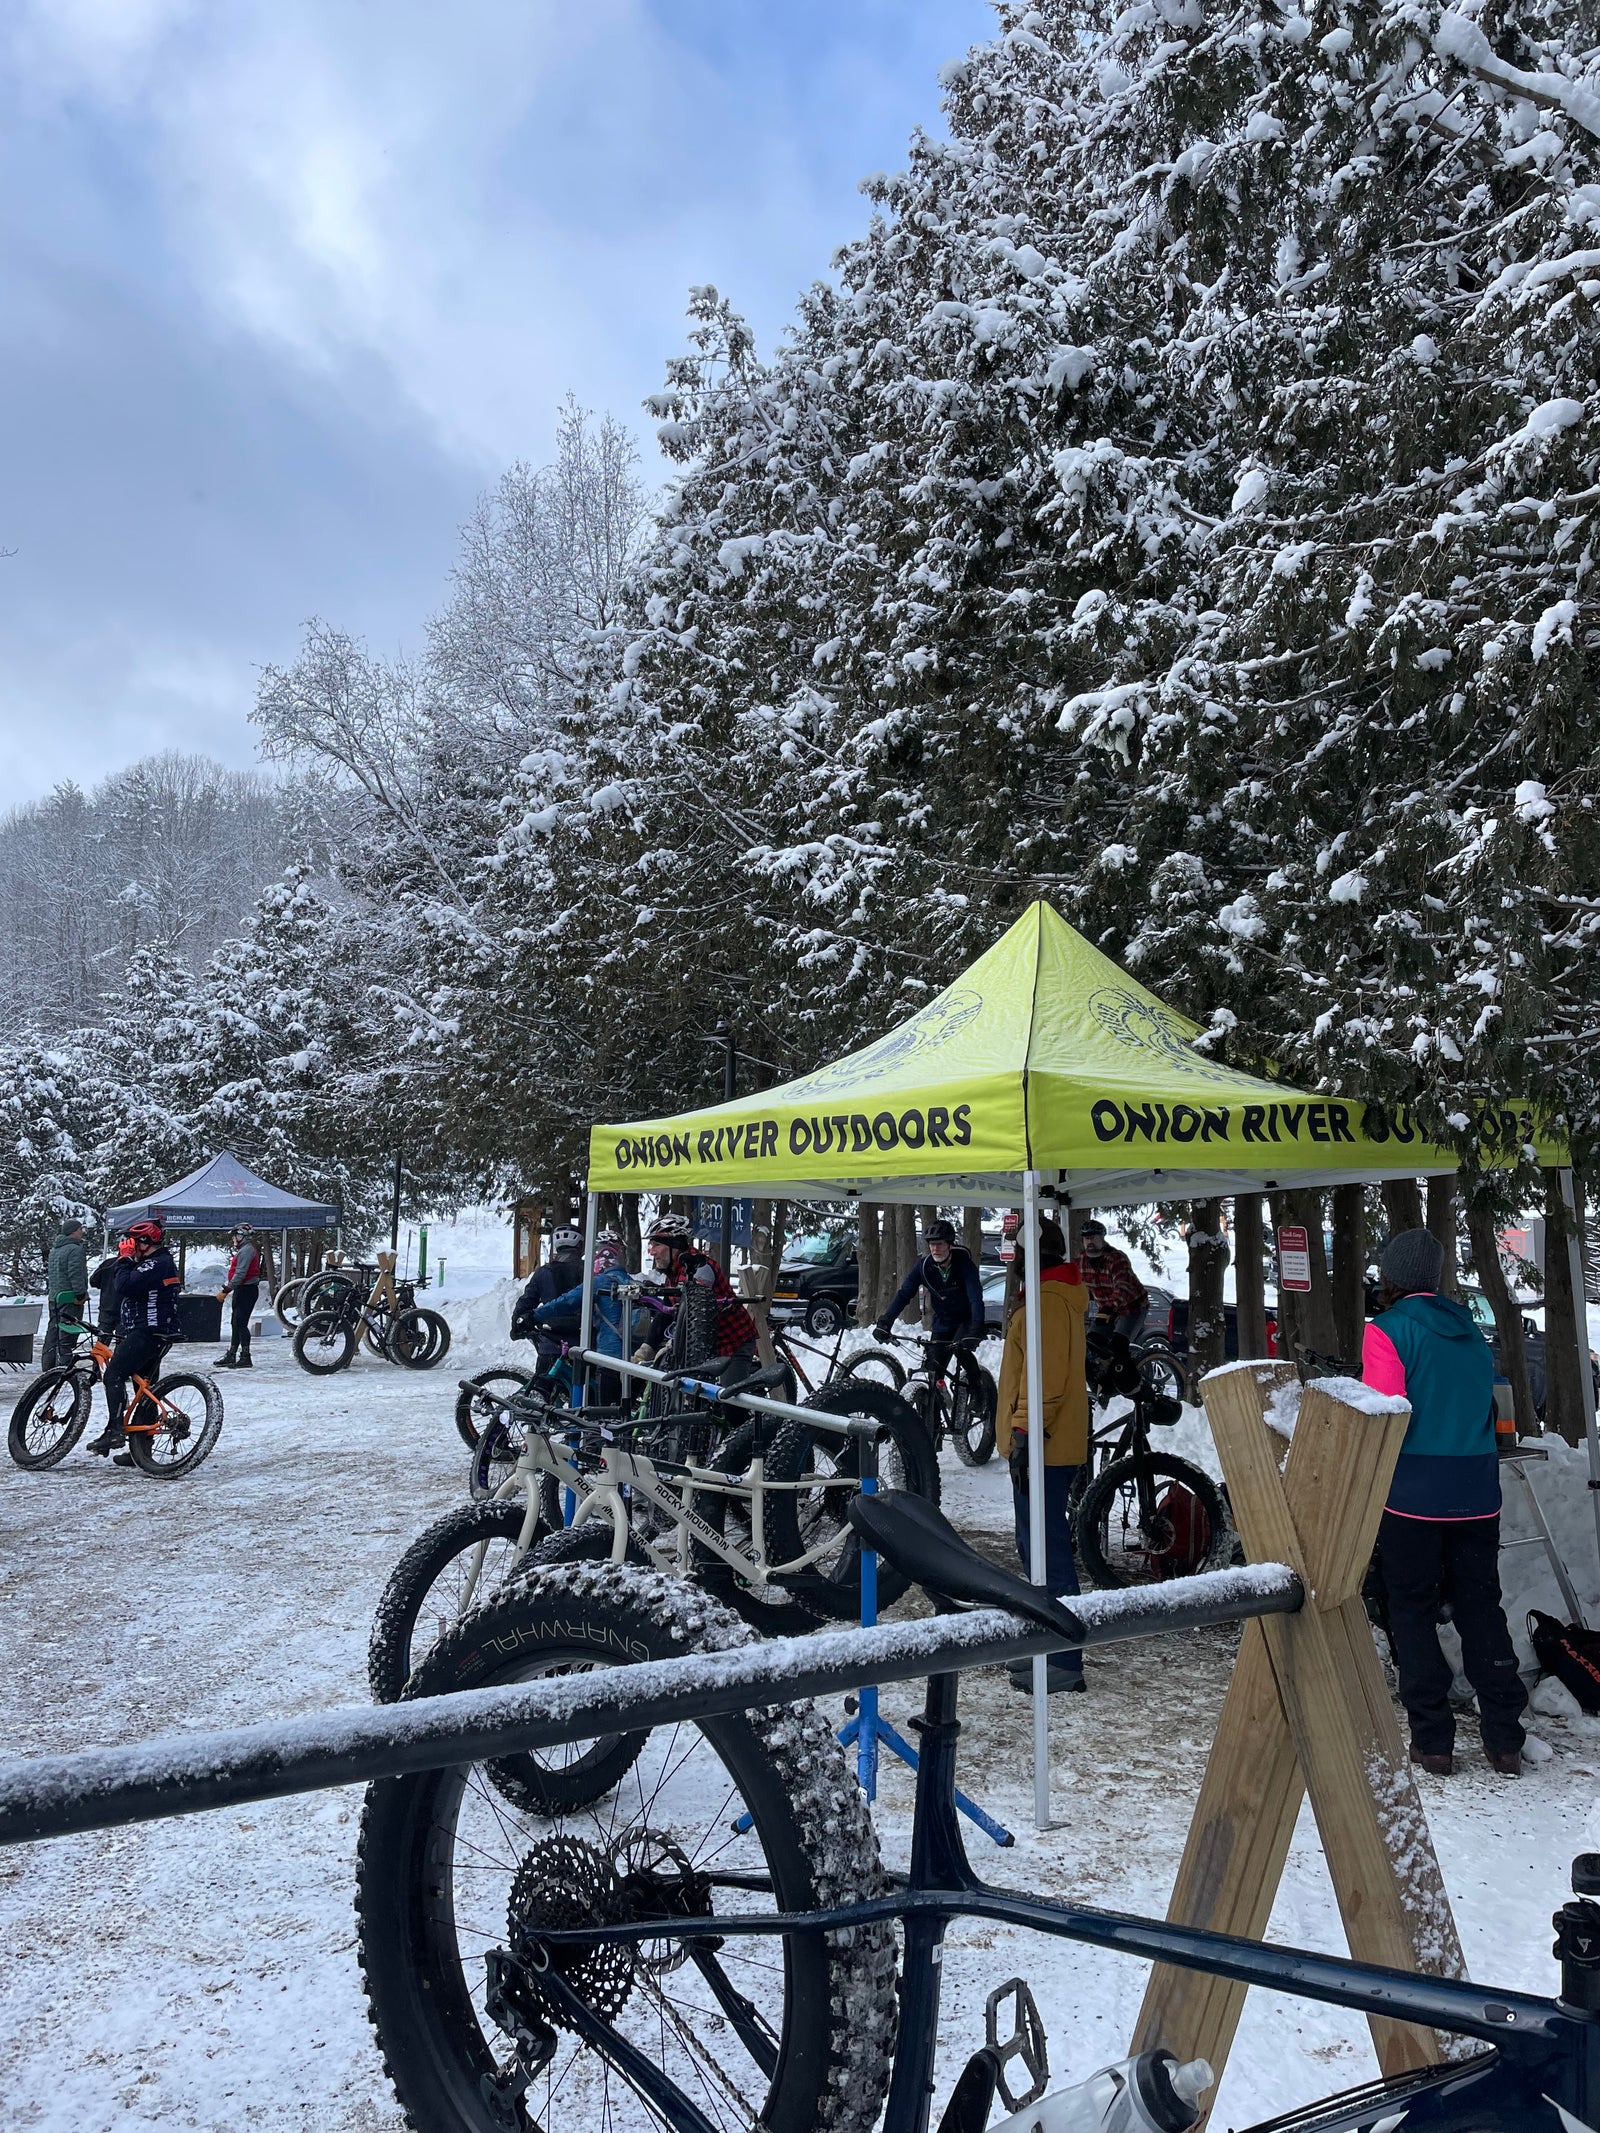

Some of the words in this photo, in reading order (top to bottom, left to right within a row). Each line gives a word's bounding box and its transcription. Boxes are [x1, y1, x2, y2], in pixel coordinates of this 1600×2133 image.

[615, 1131, 692, 1170] ONION
[698, 1120, 778, 1164] RIVER
[789, 1103, 972, 1156] OUTDOORS
[1091, 1099, 1230, 1143] ONION
[1242, 1103, 1356, 1143] RIVER
[1362, 1104, 1536, 1145] UORS
[574, 1477, 594, 1495] ROC
[654, 1484, 686, 1511] ROCKY
[683, 1509, 730, 1551] MOUNTAIN
[481, 1619, 650, 1662] GNARWHAL
